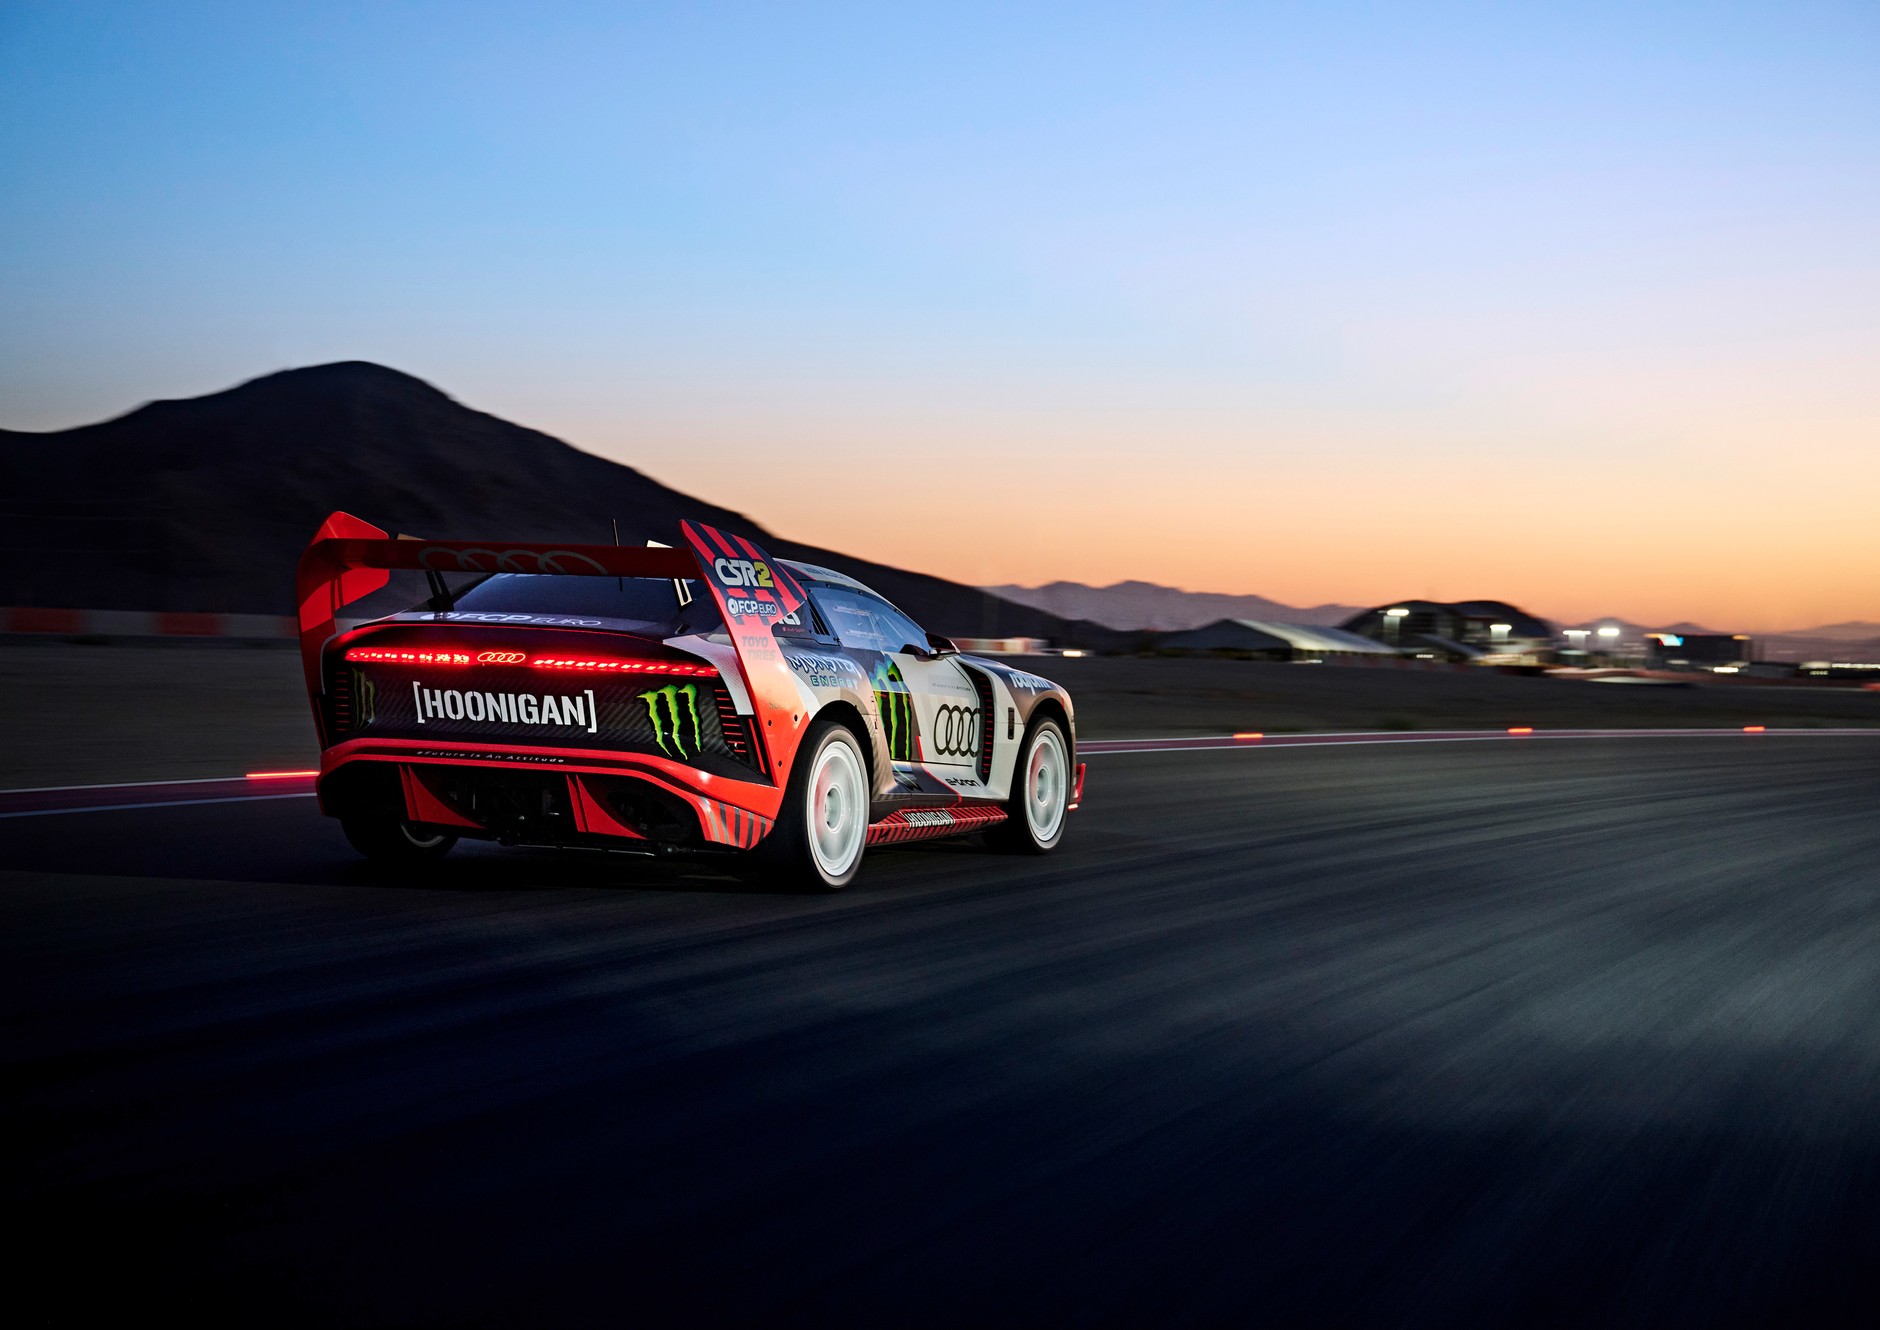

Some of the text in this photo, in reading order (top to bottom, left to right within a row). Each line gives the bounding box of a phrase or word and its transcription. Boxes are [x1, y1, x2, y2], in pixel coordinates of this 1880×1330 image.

[715, 558, 774, 587] CSR2
[738, 600, 777, 614] FCP EURO
[453, 613, 532, 622] FCP
[742, 636, 769, 648] TOYO
[747, 649, 776, 661] TIRES
[810, 675, 859, 690] ENERGY
[945, 777, 981, 787] e-tron
